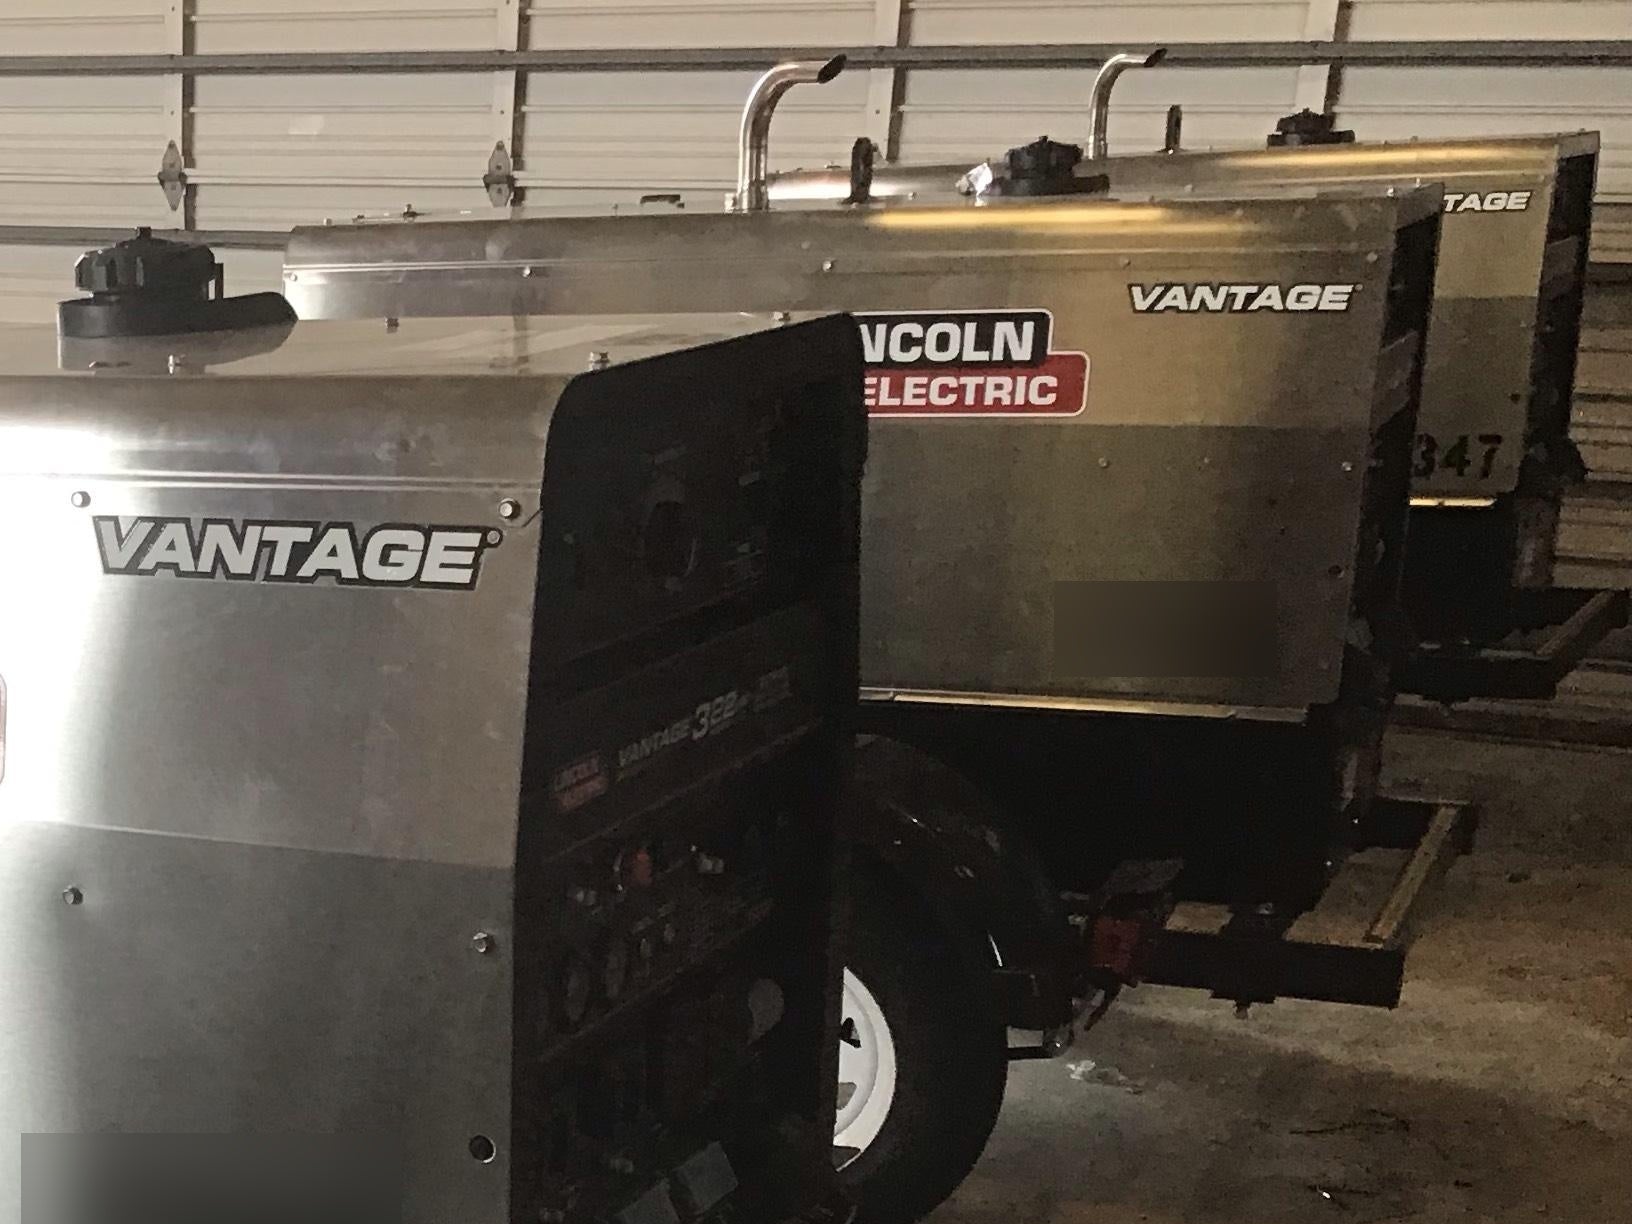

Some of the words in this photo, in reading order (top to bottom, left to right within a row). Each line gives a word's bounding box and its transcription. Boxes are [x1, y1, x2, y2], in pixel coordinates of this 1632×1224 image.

[1444, 191, 1531, 212] TAGE
[1130, 284, 1355, 311] VANTAGE
[97, 519, 484, 585] VANTAGE
